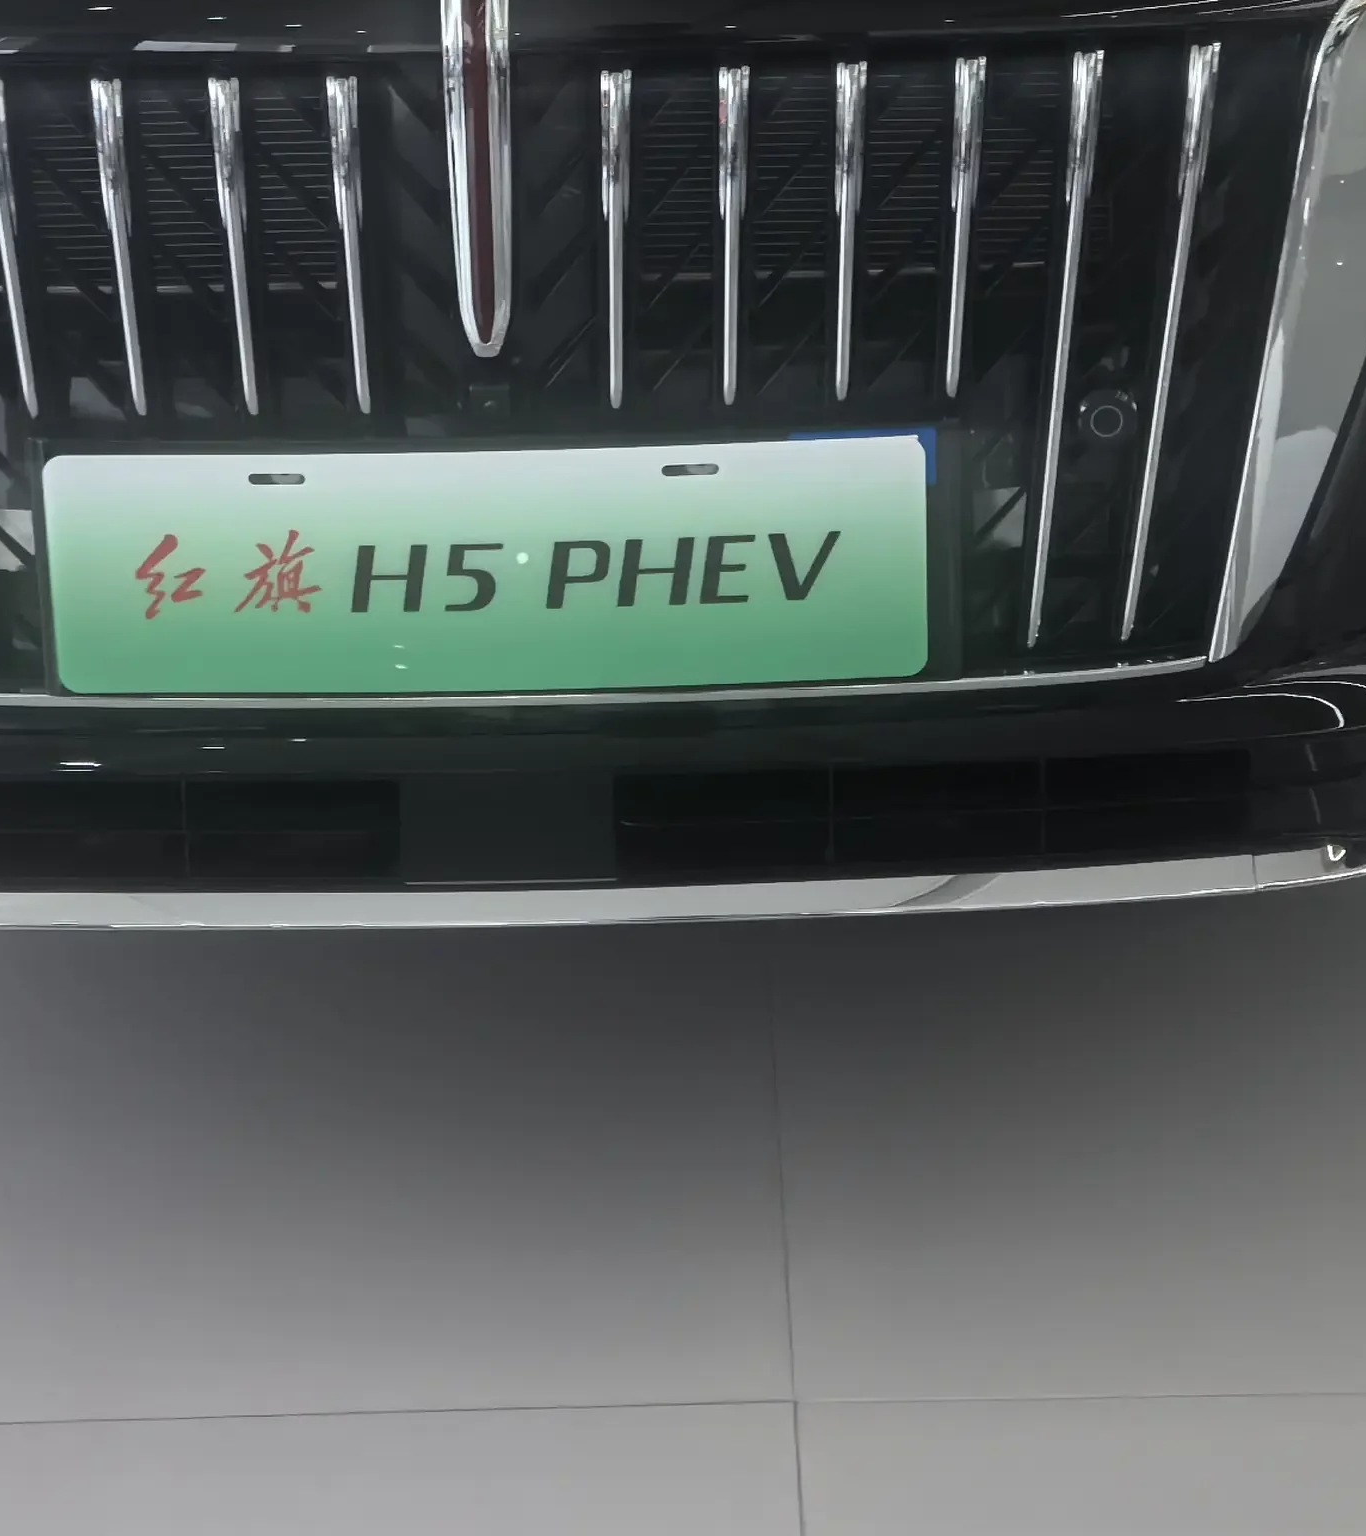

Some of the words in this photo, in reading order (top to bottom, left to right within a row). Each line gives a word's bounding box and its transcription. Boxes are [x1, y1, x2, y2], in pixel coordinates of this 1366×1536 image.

[134, 529, 323, 619] 红旗
[350, 542, 505, 614] H5
[546, 530, 842, 611] PHEV
